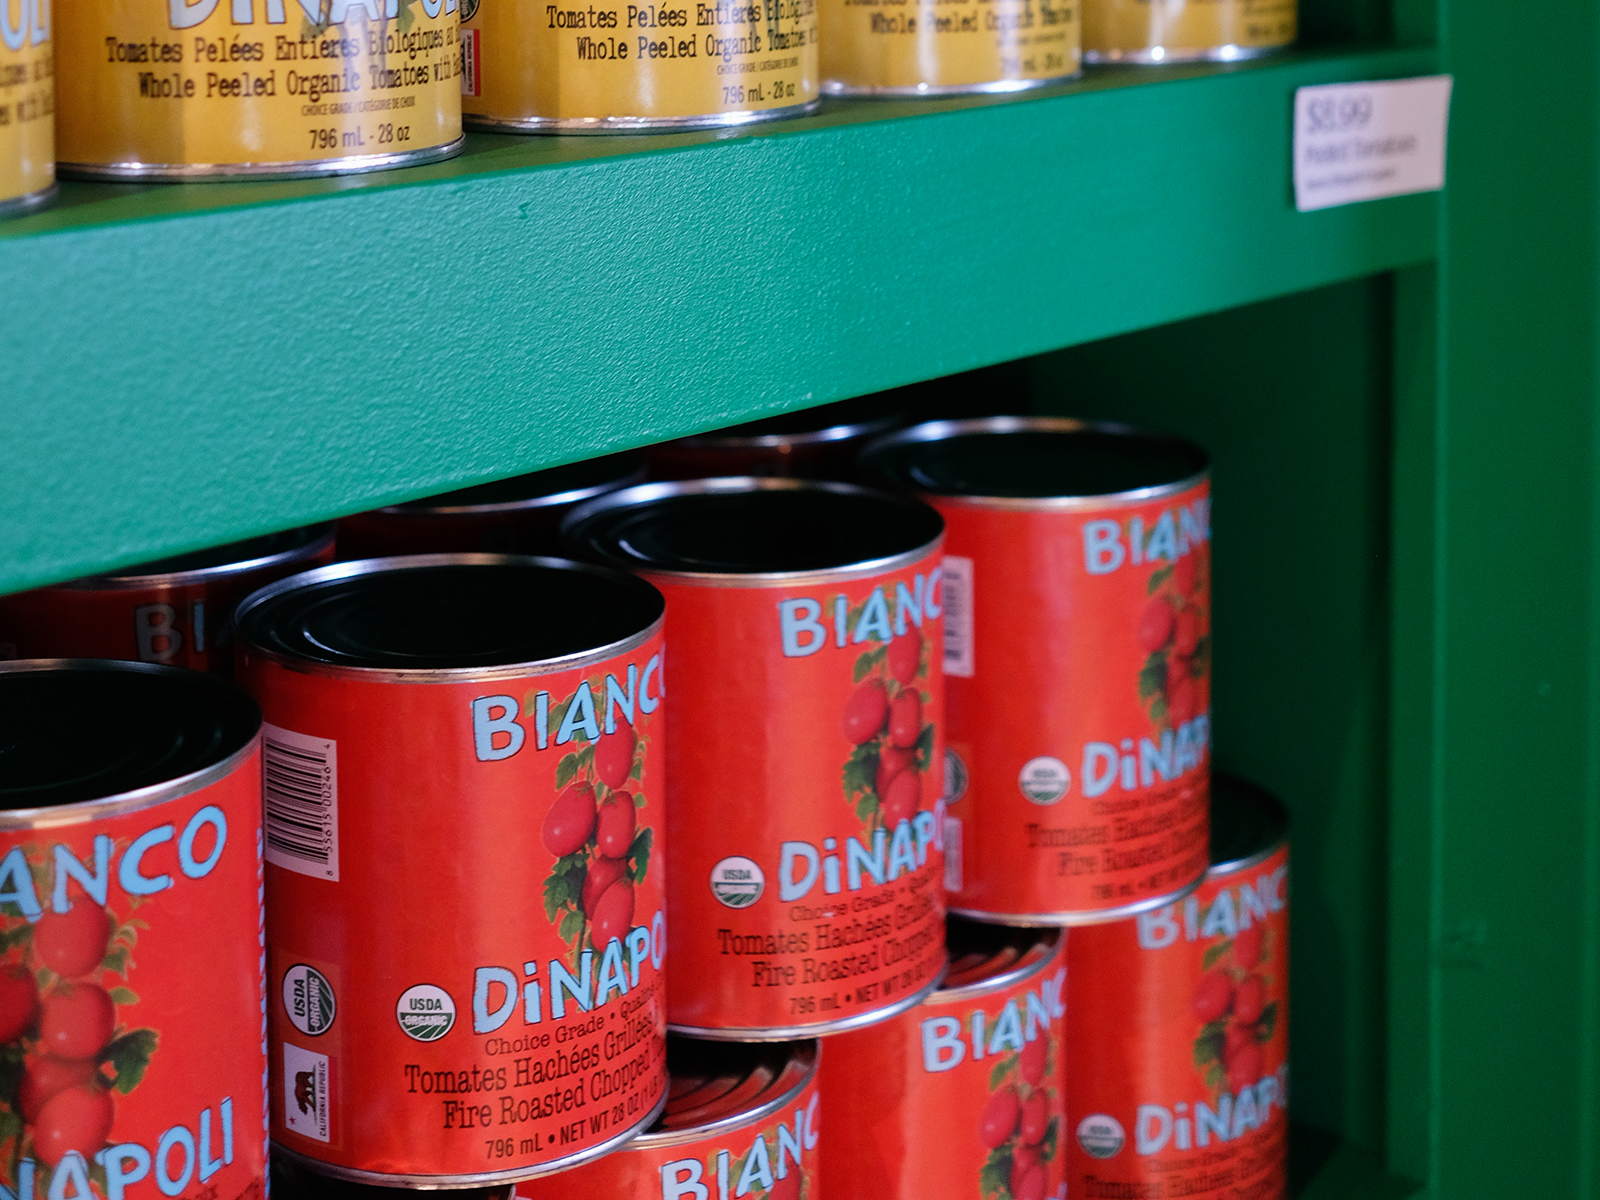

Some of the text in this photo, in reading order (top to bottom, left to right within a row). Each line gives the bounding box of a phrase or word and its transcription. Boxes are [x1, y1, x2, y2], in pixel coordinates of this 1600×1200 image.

[546, 4, 618, 29] Tomates
[627, 1, 687, 29] Pelées
[105, 36, 184, 64] Tomates
[194, 33, 265, 63] Pelées
[367, 26, 444, 61] Biologiques
[576, 36, 628, 60] Whole
[637, 34, 697, 60] Peeled
[705, 33, 762, 63] Organic
[138, 71, 196, 99] Whole
[206, 70, 276, 98] Peeled
[286, 69, 362, 103] Organic
[369, 61, 430, 91] Tomatoes
[722, 86, 744, 105] 796
[747, 83, 765, 102] mL
[308, 127, 338, 150] 796
[342, 127, 366, 149] mL
[377, 123, 393, 145] 28
[396, 124, 411, 142] oz
[320, 766, 333, 808] 00246
[321, 813, 334, 853] 55615
[717, 927, 810, 957] Tomates
[751, 960, 797, 988] Fire
[802, 944, 879, 985] Roasted
[294, 977, 306, 1018] USDA
[308, 975, 321, 1028] ORGANIC
[409, 997, 443, 1011] USDA
[404, 1064, 508, 1095] Tomates
[513, 1043, 600, 1088] Hachées
[603, 1011, 652, 1061] Grillées
[484, 1031, 551, 1057] Choice
[554, 1015, 605, 1043] Grade
[318, 1060, 327, 1138] CALIFORNIA REPUBLIC
[442, 1099, 493, 1130] Fire
[498, 1084, 585, 1127] Roasted
[589, 1047, 650, 1101] Chopped
[485, 1140, 514, 1160] 796
[520, 1132, 543, 1156] mL
[559, 1119, 586, 1146] NET
[590, 1110, 609, 1136] WT
[611, 1105, 625, 1126] 28
